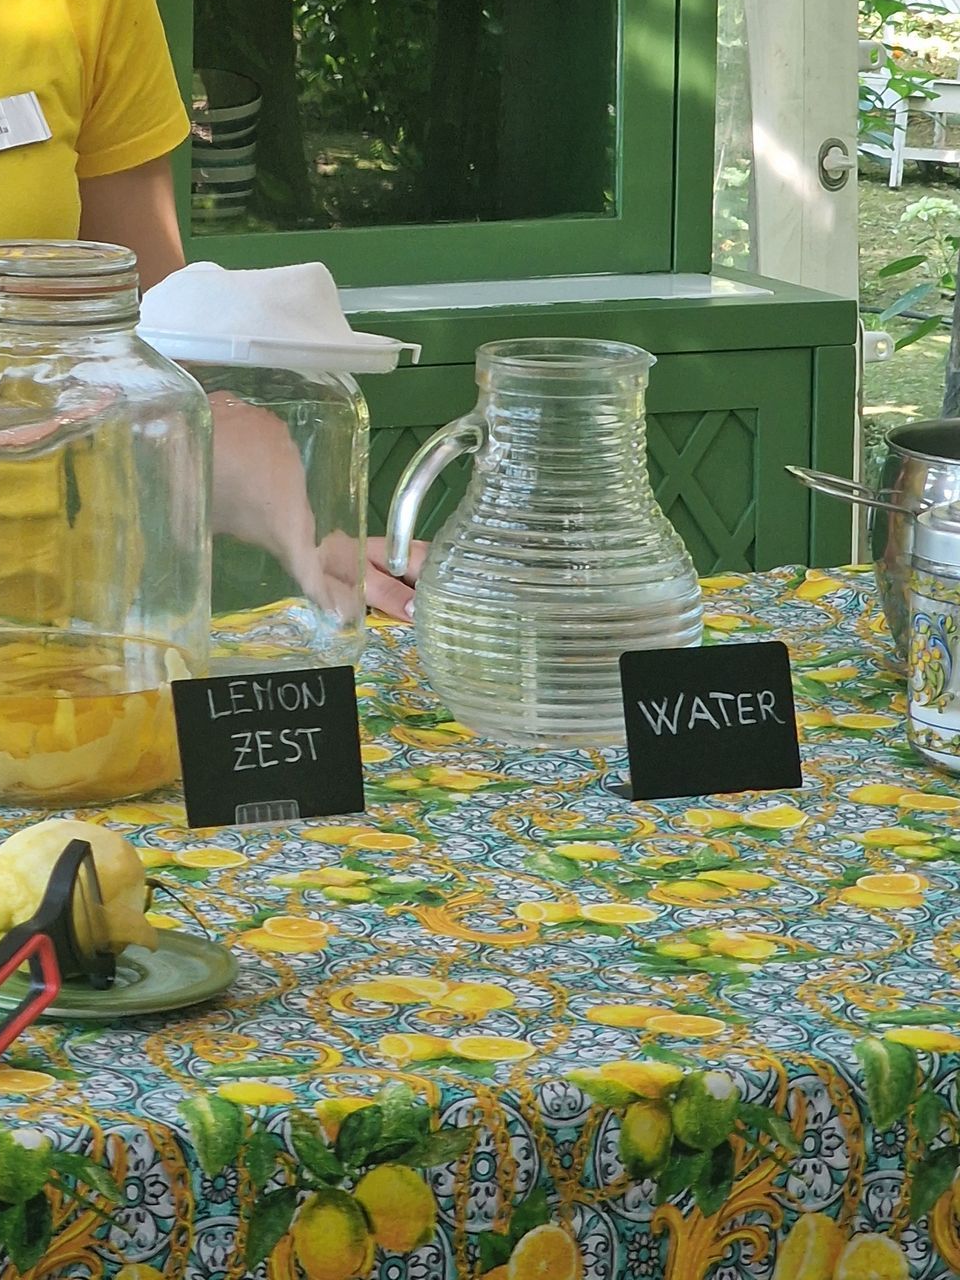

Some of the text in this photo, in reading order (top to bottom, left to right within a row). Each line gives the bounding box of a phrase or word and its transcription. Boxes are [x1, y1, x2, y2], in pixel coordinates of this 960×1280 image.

[207, 675, 326, 720] LEMON
[637, 690, 786, 735] WATER
[231, 727, 322, 771] ZEST
